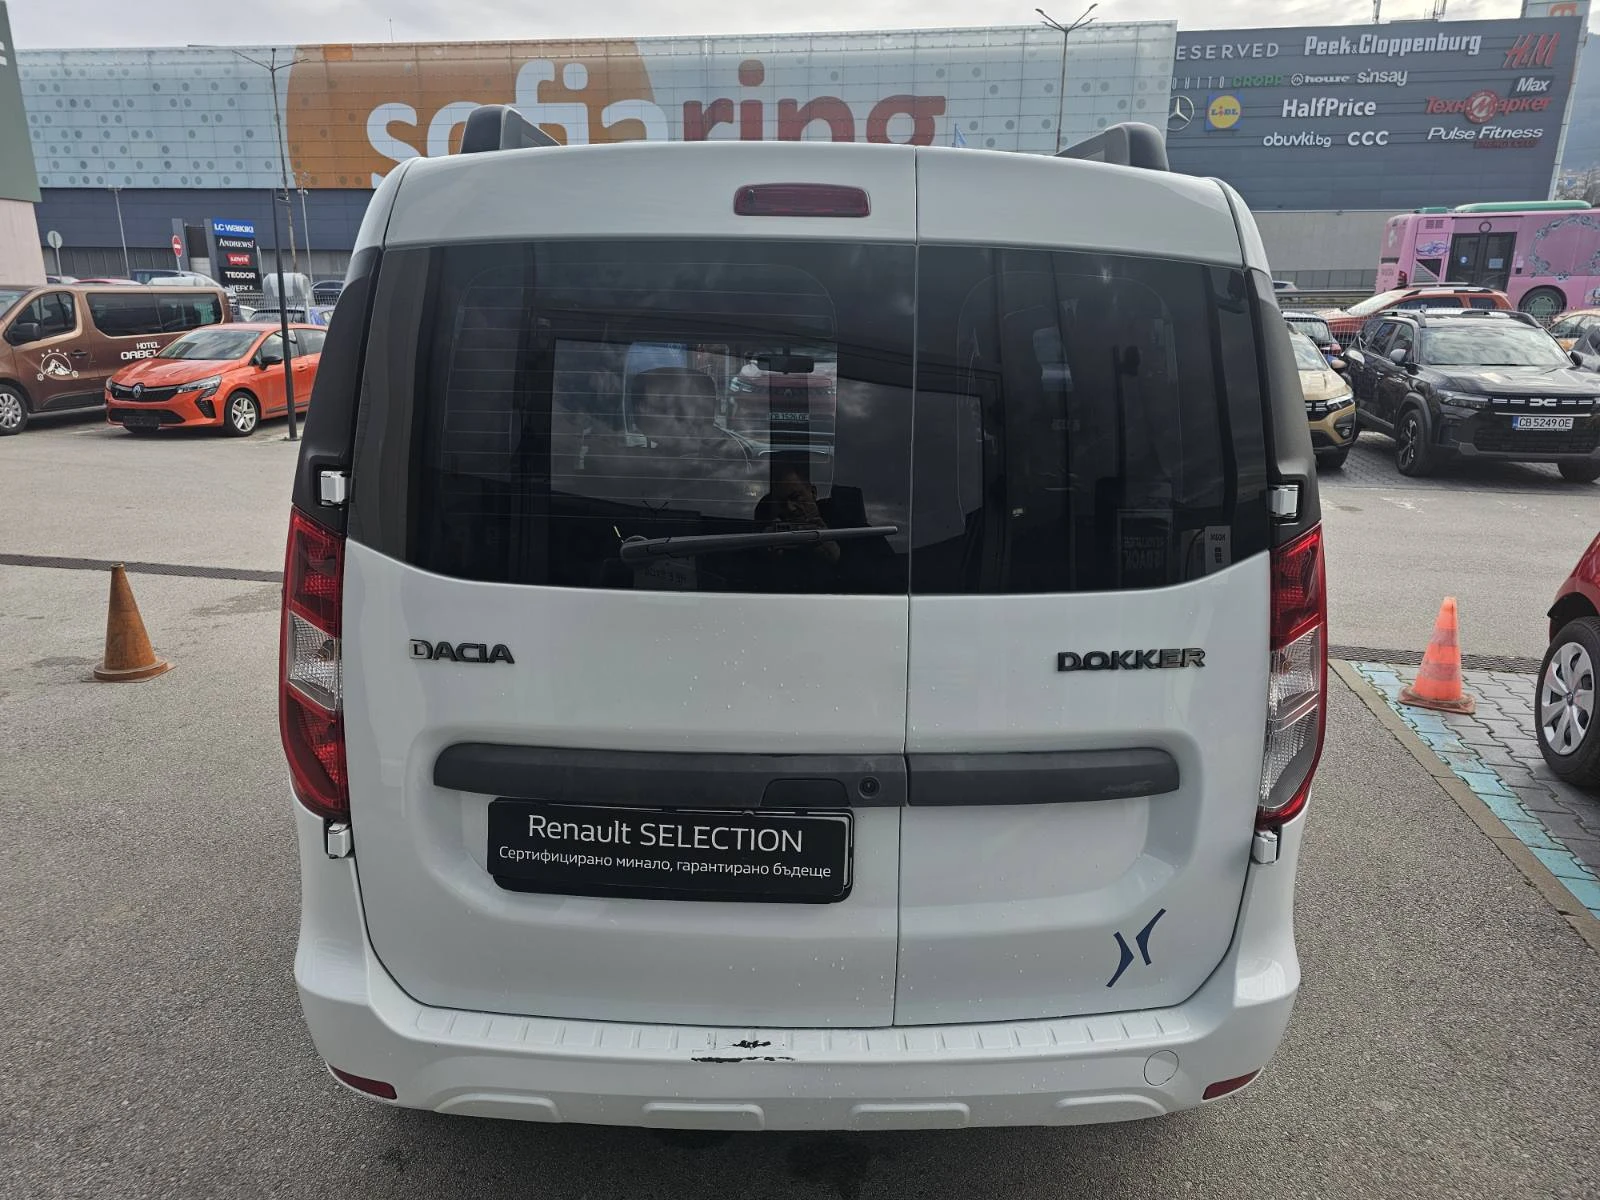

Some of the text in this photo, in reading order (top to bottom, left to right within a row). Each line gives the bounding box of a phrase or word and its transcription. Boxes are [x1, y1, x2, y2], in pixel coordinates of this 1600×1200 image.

[1175, 42, 1279, 60] ESERVED
[1172, 76, 1225, 89] OHITO
[1357, 69, 1409, 86] sinsay
[1516, 77, 1550, 92] Max
[1282, 97, 1377, 118] HalfPrice
[1263, 131, 1332, 147] obuvki.bg
[1347, 130, 1389, 146] CCC
[1427, 125, 1544, 140] Pulse Fitness
[213, 223, 225, 231] LC
[225, 271, 255, 279] TEODOR
[136, 341, 160, 349] HOTEL
[409, 638, 515, 665] DACIA
[1057, 648, 1205, 672] DOKKER
[528, 814, 803, 853] Renault SELECTION
[499, 845, 832, 878] Сертифицирано минало, гарантирано бъдеще
